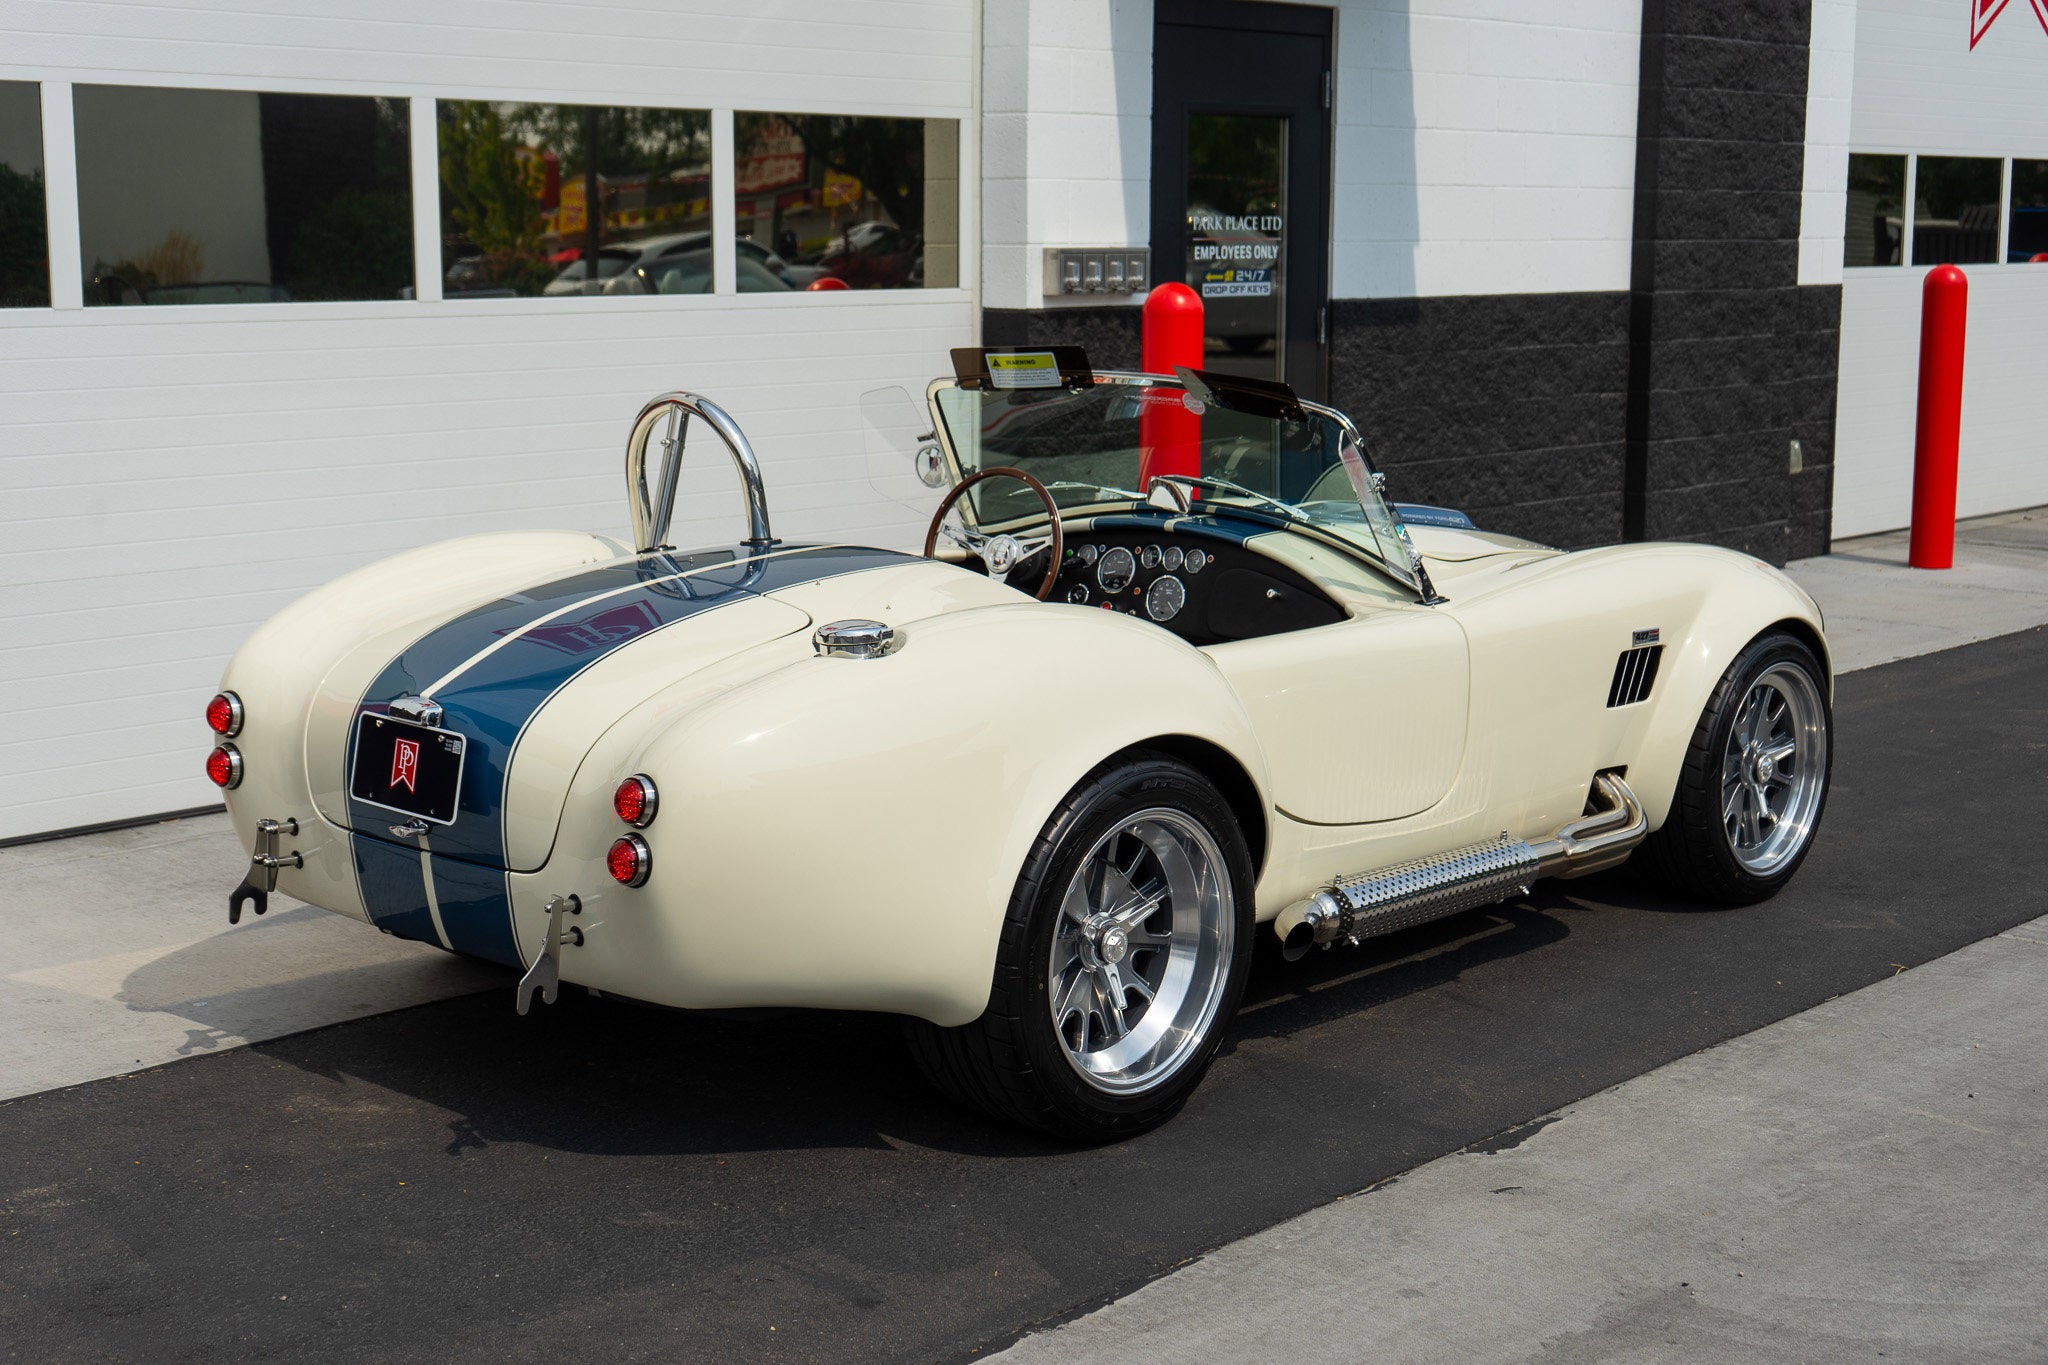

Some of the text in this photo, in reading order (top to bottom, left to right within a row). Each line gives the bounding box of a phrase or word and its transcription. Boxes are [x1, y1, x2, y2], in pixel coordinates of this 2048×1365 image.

[1193, 216, 1282, 230] PARK PLACE LTD
[1194, 245, 1279, 260] EMPLOYEES ONLY
[1236, 270, 1265, 281] 24/7
[1204, 285, 1269, 294] DROP OFF KEYS
